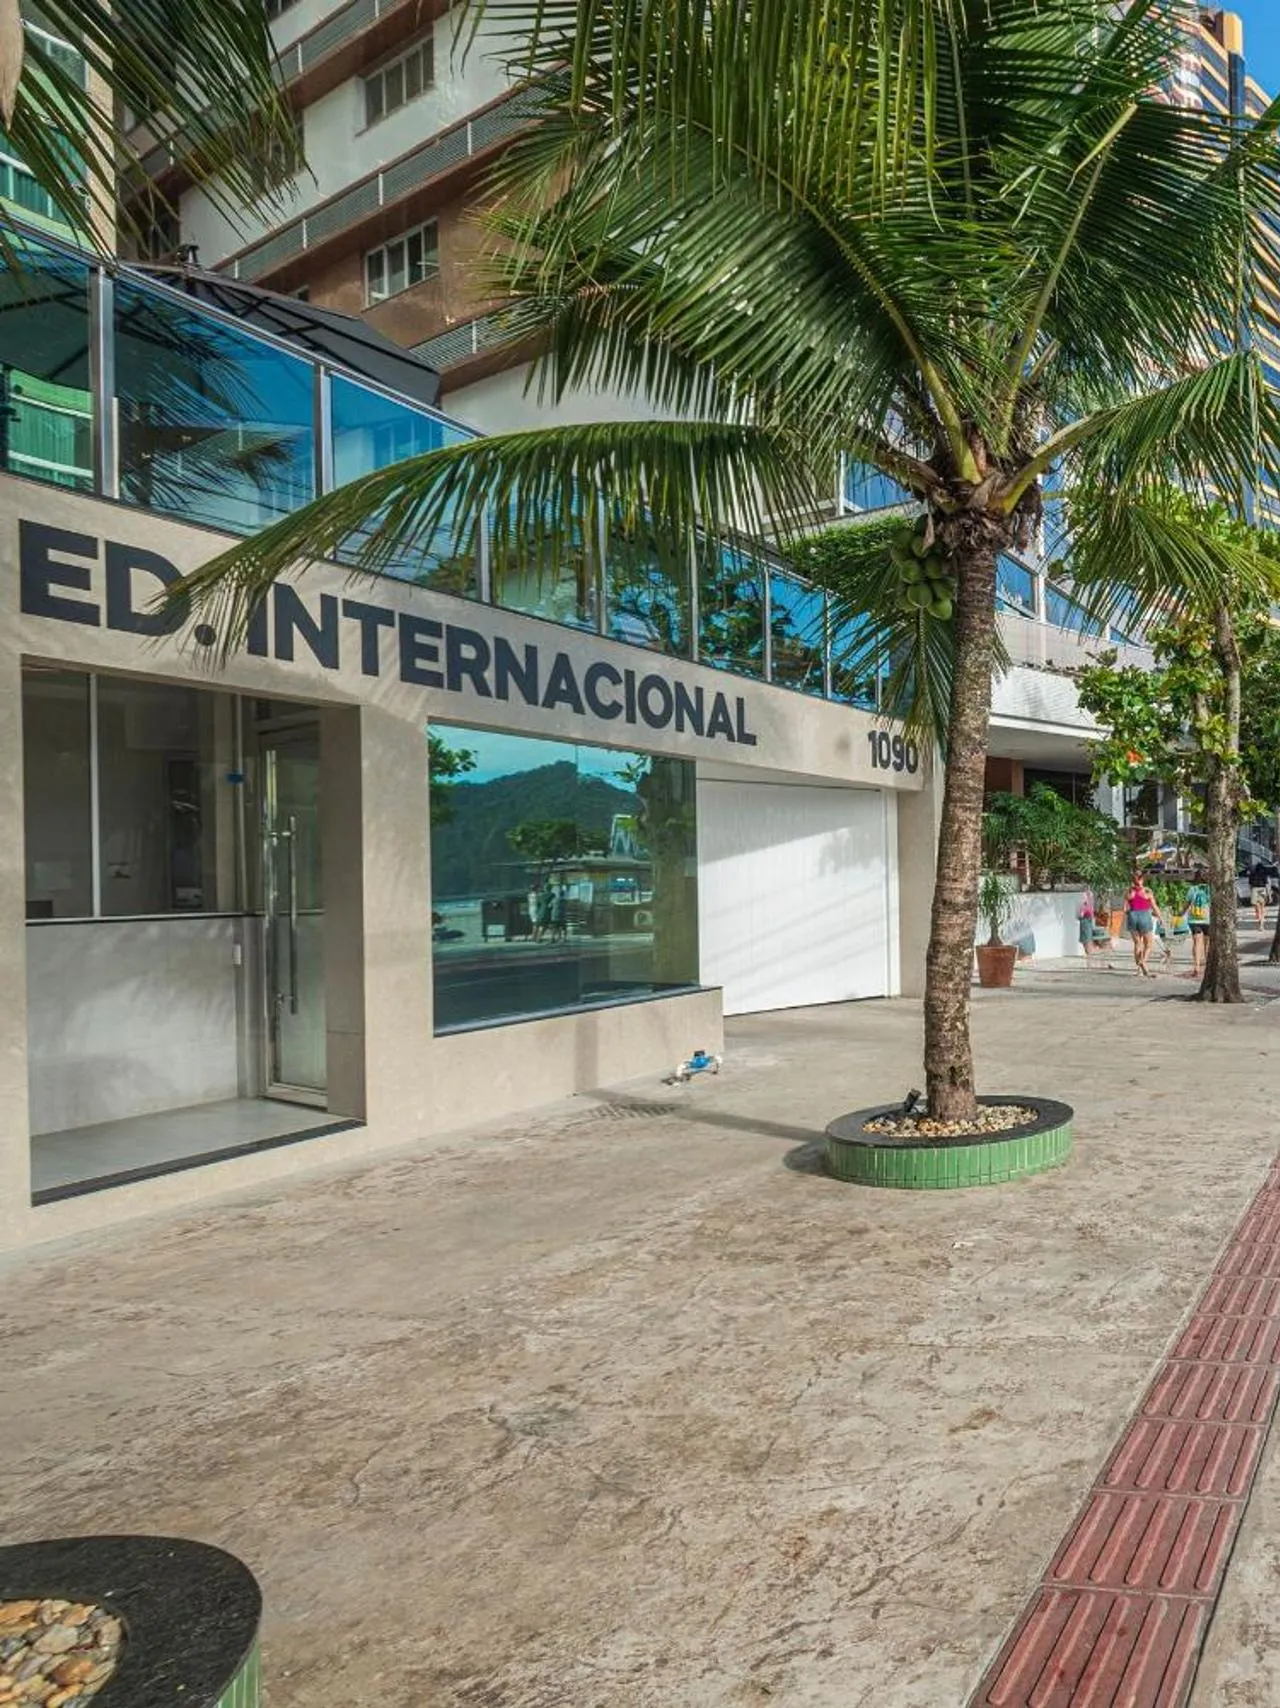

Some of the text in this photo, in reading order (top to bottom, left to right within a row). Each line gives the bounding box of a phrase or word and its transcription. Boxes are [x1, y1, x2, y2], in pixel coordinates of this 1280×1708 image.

[19, 519, 757, 745] ED. INTERNACIONAL
[868, 730, 919, 774] 1090
